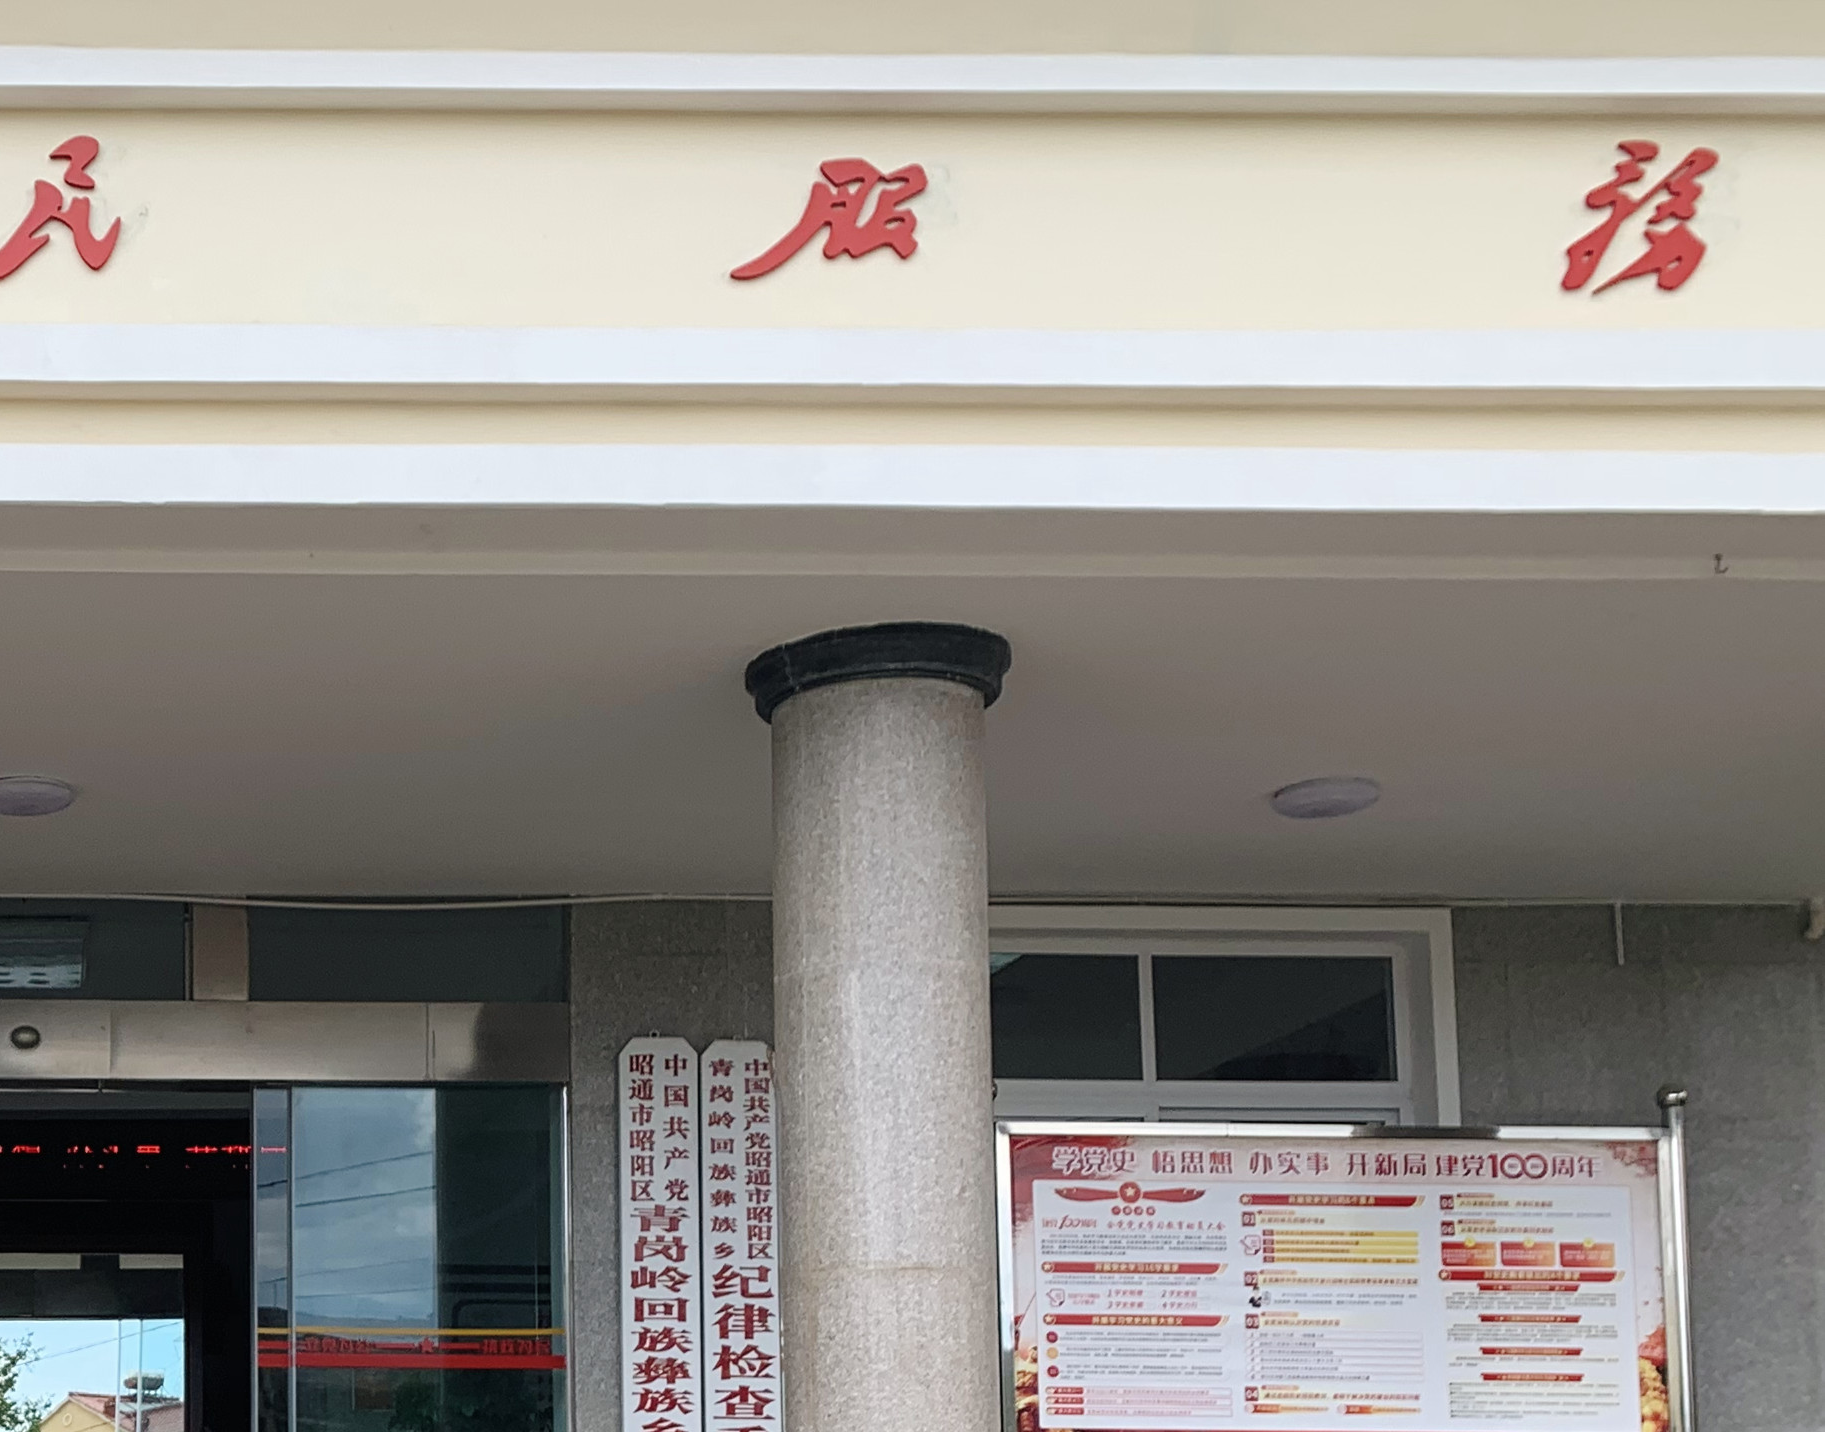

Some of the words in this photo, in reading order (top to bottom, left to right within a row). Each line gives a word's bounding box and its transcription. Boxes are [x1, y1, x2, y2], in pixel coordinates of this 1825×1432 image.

[627, 1053, 655, 1202] 昭通市昭阳区
[663, 1053, 690, 1202] 中国共产党
[744, 1058, 775, 1260] 中国共产党昭通市昭阳区
[1053, 1146, 1135, 1175] 学党史
[1152, 1149, 1234, 1175] 悟思想
[1249, 1151, 1330, 1176] 办实事
[1347, 1152, 1427, 1177] 开新局
[1435, 1153, 1602, 1179] 建党100周年
